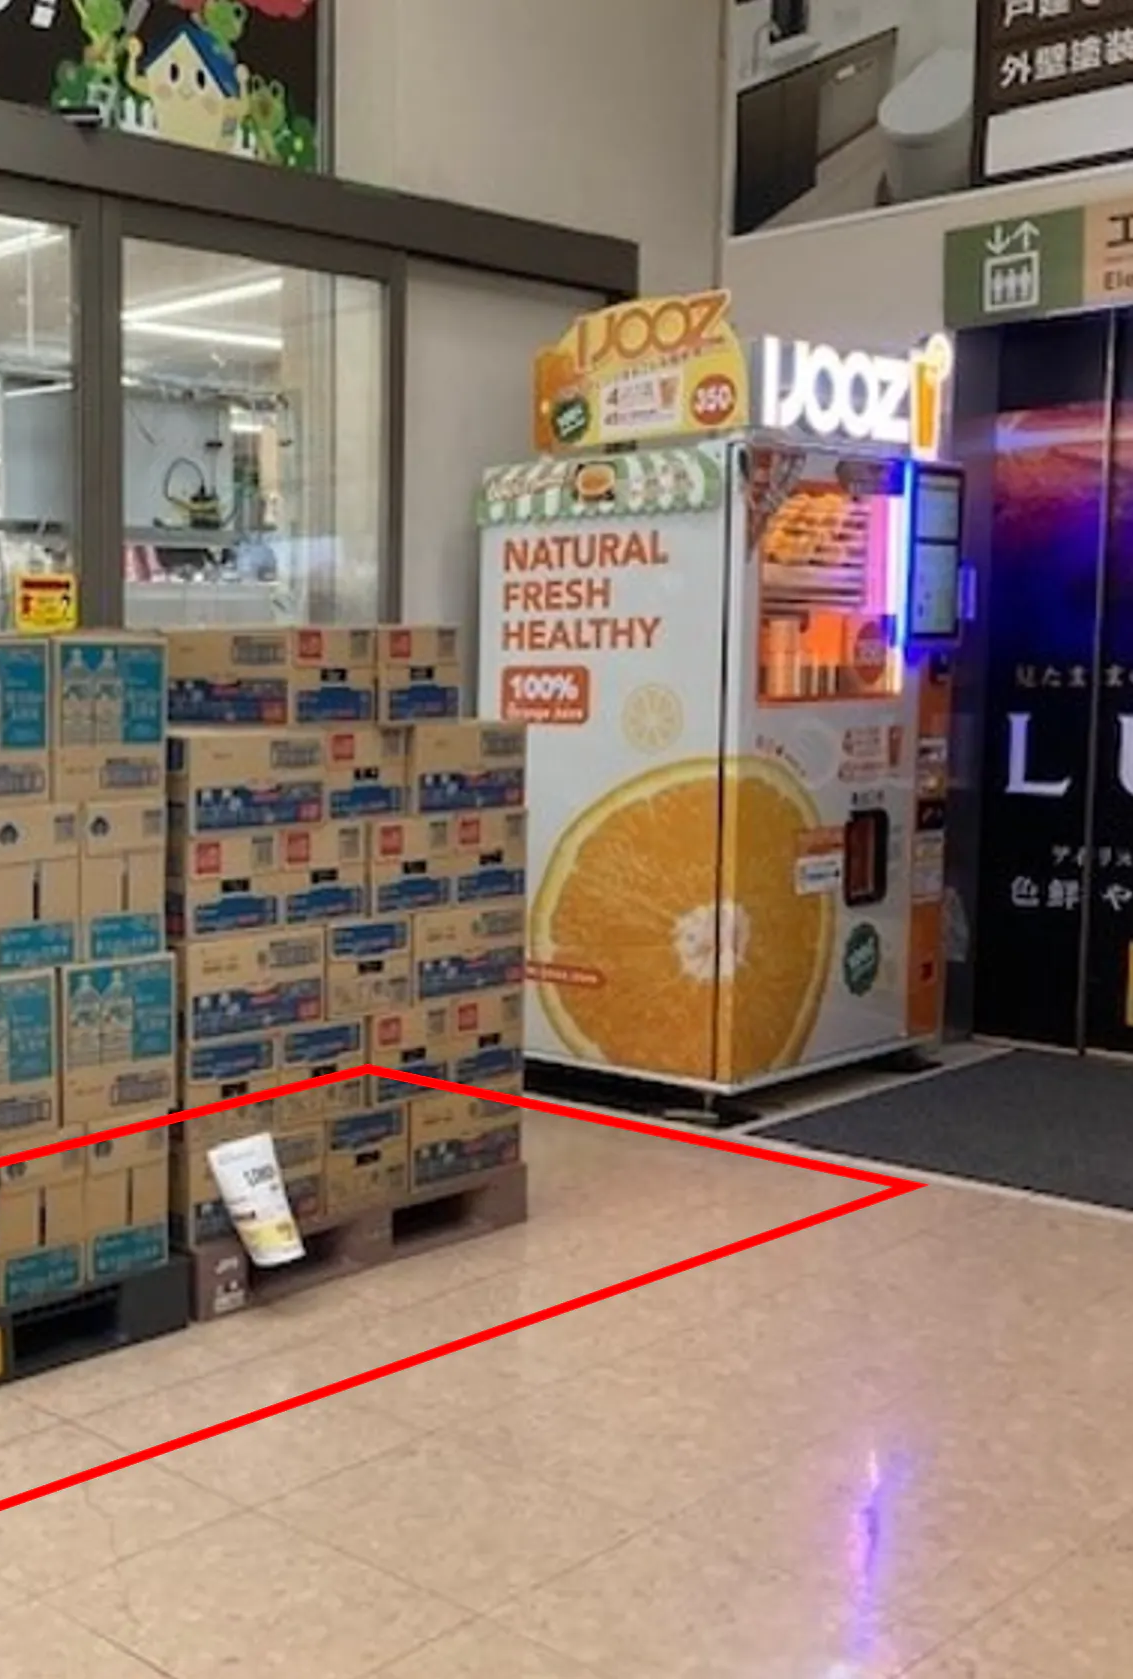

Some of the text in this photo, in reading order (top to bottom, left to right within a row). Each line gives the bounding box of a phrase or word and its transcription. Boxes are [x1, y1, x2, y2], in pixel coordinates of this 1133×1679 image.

[502, 530, 668, 572] NATURAL
[502, 579, 611, 612] FRESH
[501, 617, 662, 651] HEALTHY
[509, 672, 580, 700] 100%
